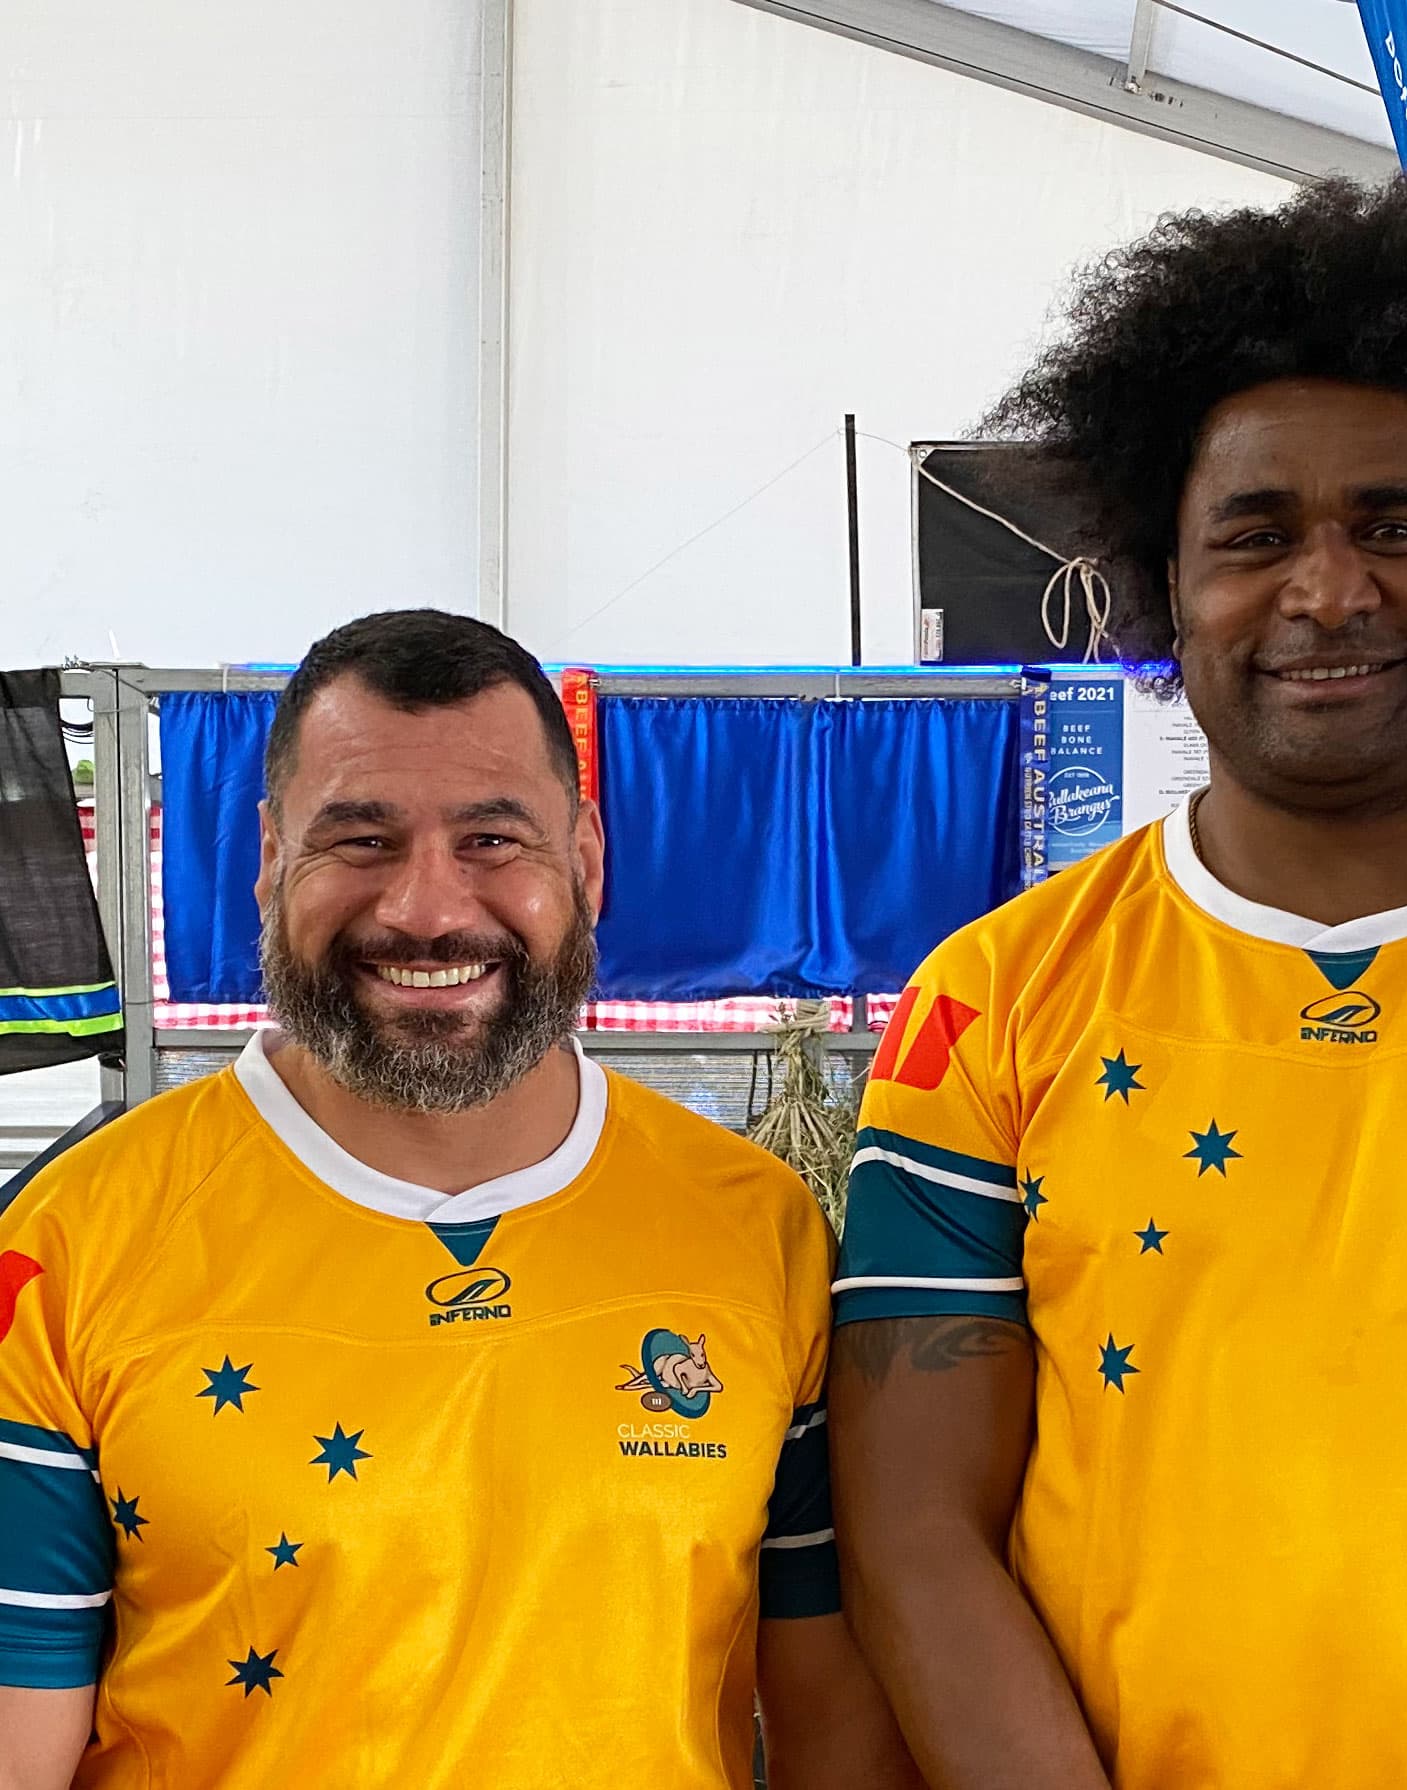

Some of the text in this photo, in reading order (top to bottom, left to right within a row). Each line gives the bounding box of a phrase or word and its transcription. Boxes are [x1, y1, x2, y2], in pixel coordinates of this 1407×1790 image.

[1049, 686, 1115, 701] eef 2021
[575, 689, 589, 751] BEEF
[1062, 724, 1091, 733] BEEF
[1061, 735, 1092, 744] BONE
[1049, 746, 1104, 756] BALANCE
[1032, 700, 1047, 884] BEEF AUSTRAL
[1300, 1026, 1378, 1044] INFERNO
[429, 1304, 512, 1326] INFERNO
[616, 1423, 691, 1439] CLASSIC
[618, 1440, 728, 1459] WALLABIES
